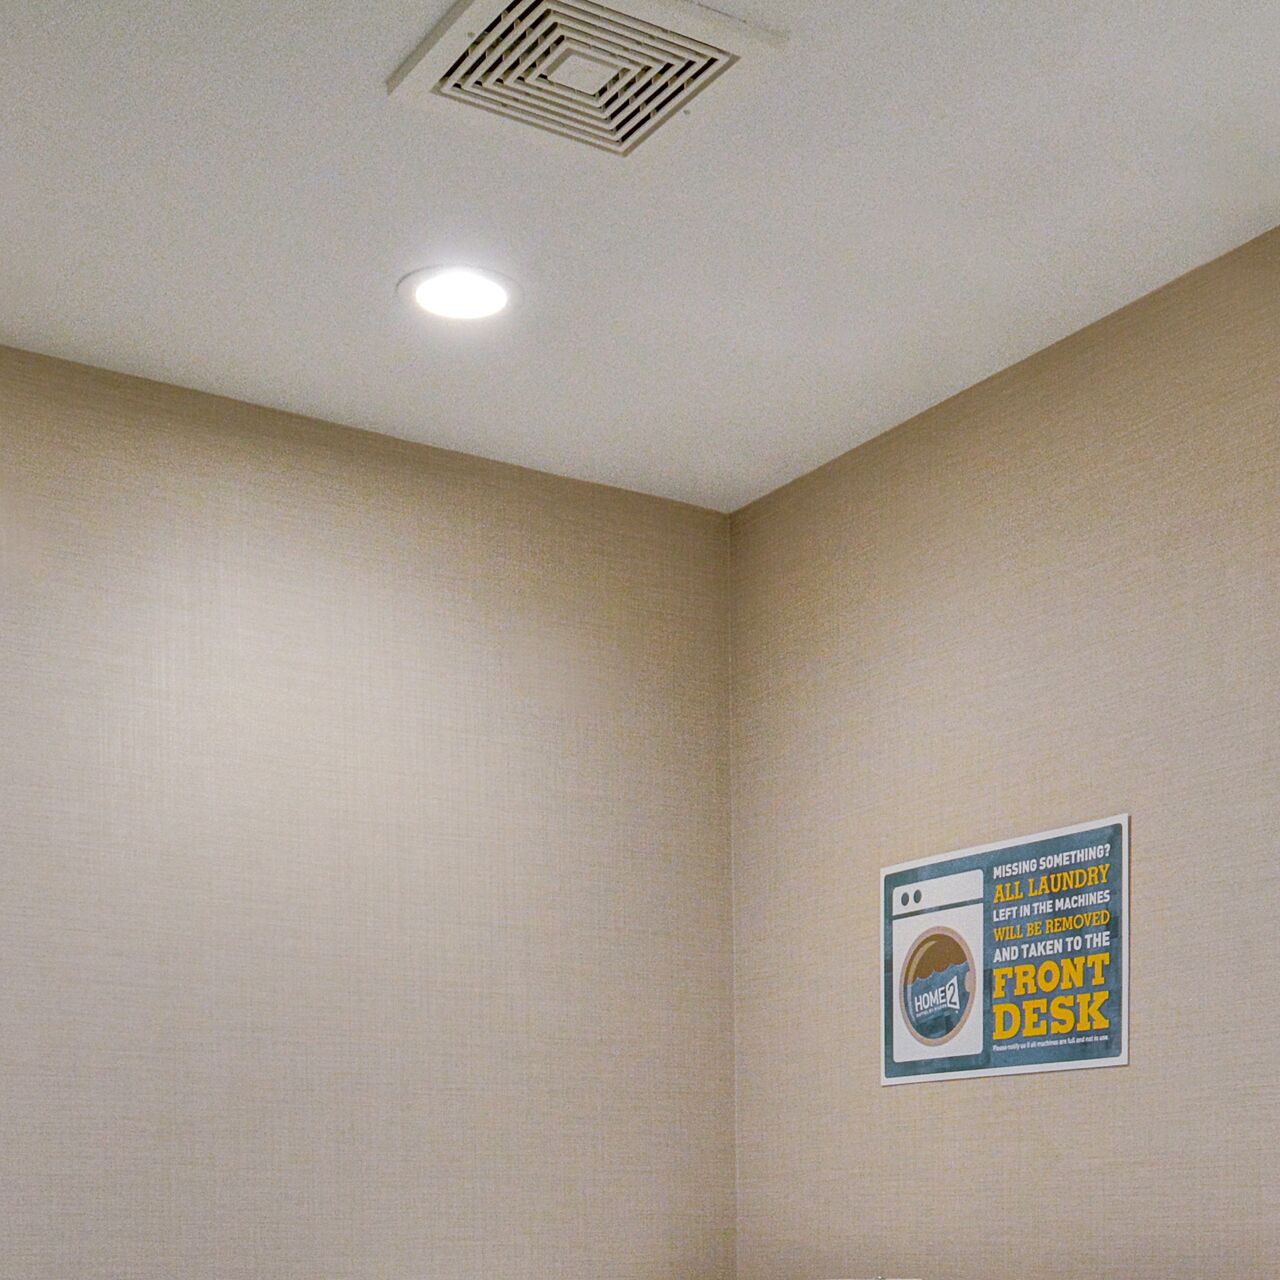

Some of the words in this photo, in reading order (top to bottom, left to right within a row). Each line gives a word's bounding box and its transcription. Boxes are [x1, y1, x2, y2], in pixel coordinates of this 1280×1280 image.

[993, 859, 1037, 879] MISSING
[1040, 844, 1110, 869] SOMETHING?
[993, 880, 1023, 904] ALL
[1029, 864, 1110, 897] LAUNDRY
[993, 906, 1017, 921] LEFT
[1020, 905, 1030, 917] IN
[1032, 901, 1053, 915] THE
[1055, 890, 1110, 911] MACHINES
[993, 923, 1023, 941] WILL
[1027, 922, 1041, 936] BE
[1046, 910, 1110, 934] REMOVED
[993, 946, 1019, 963] AND
[1022, 939, 1062, 958] TAKEN
[1066, 936, 1081, 951] TO
[1085, 932, 1110, 948] THE
[993, 952, 1110, 998] FRONT
[993, 991, 1109, 1040] DESK
